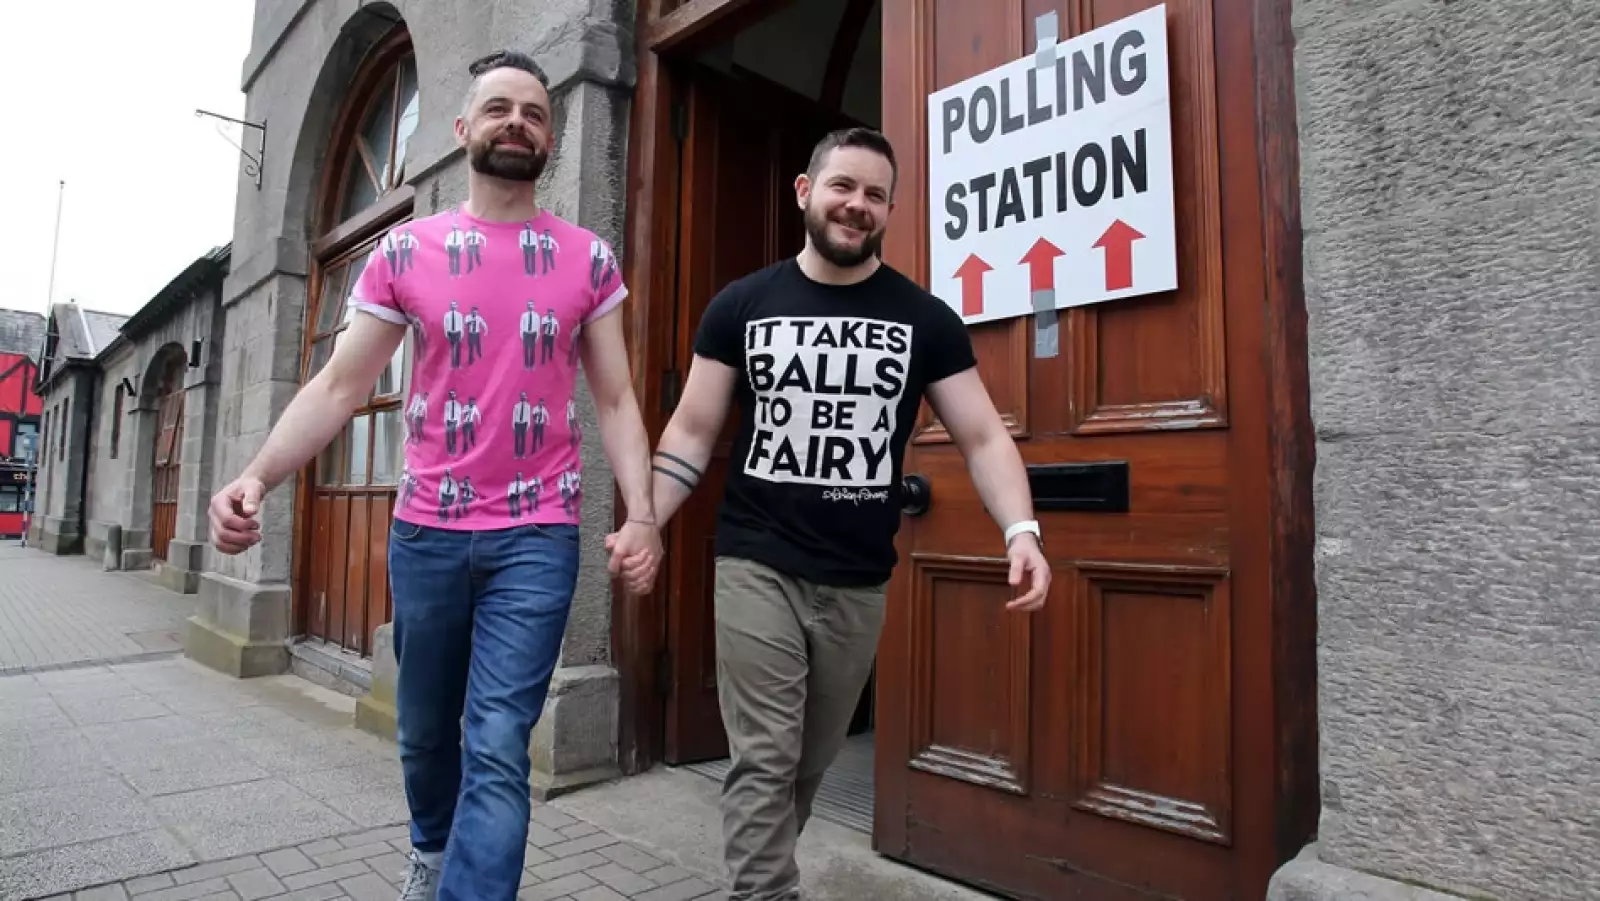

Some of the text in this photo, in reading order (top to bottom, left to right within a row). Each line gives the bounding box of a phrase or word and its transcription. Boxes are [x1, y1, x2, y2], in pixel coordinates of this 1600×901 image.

[942, 29, 1147, 155] POLLING
[944, 127, 1148, 241] STATION
[749, 320, 907, 354] IT TAKES
[750, 352, 904, 399] BALLS
[758, 396, 890, 432] TO BE A
[748, 429, 888, 480] FAIRY
